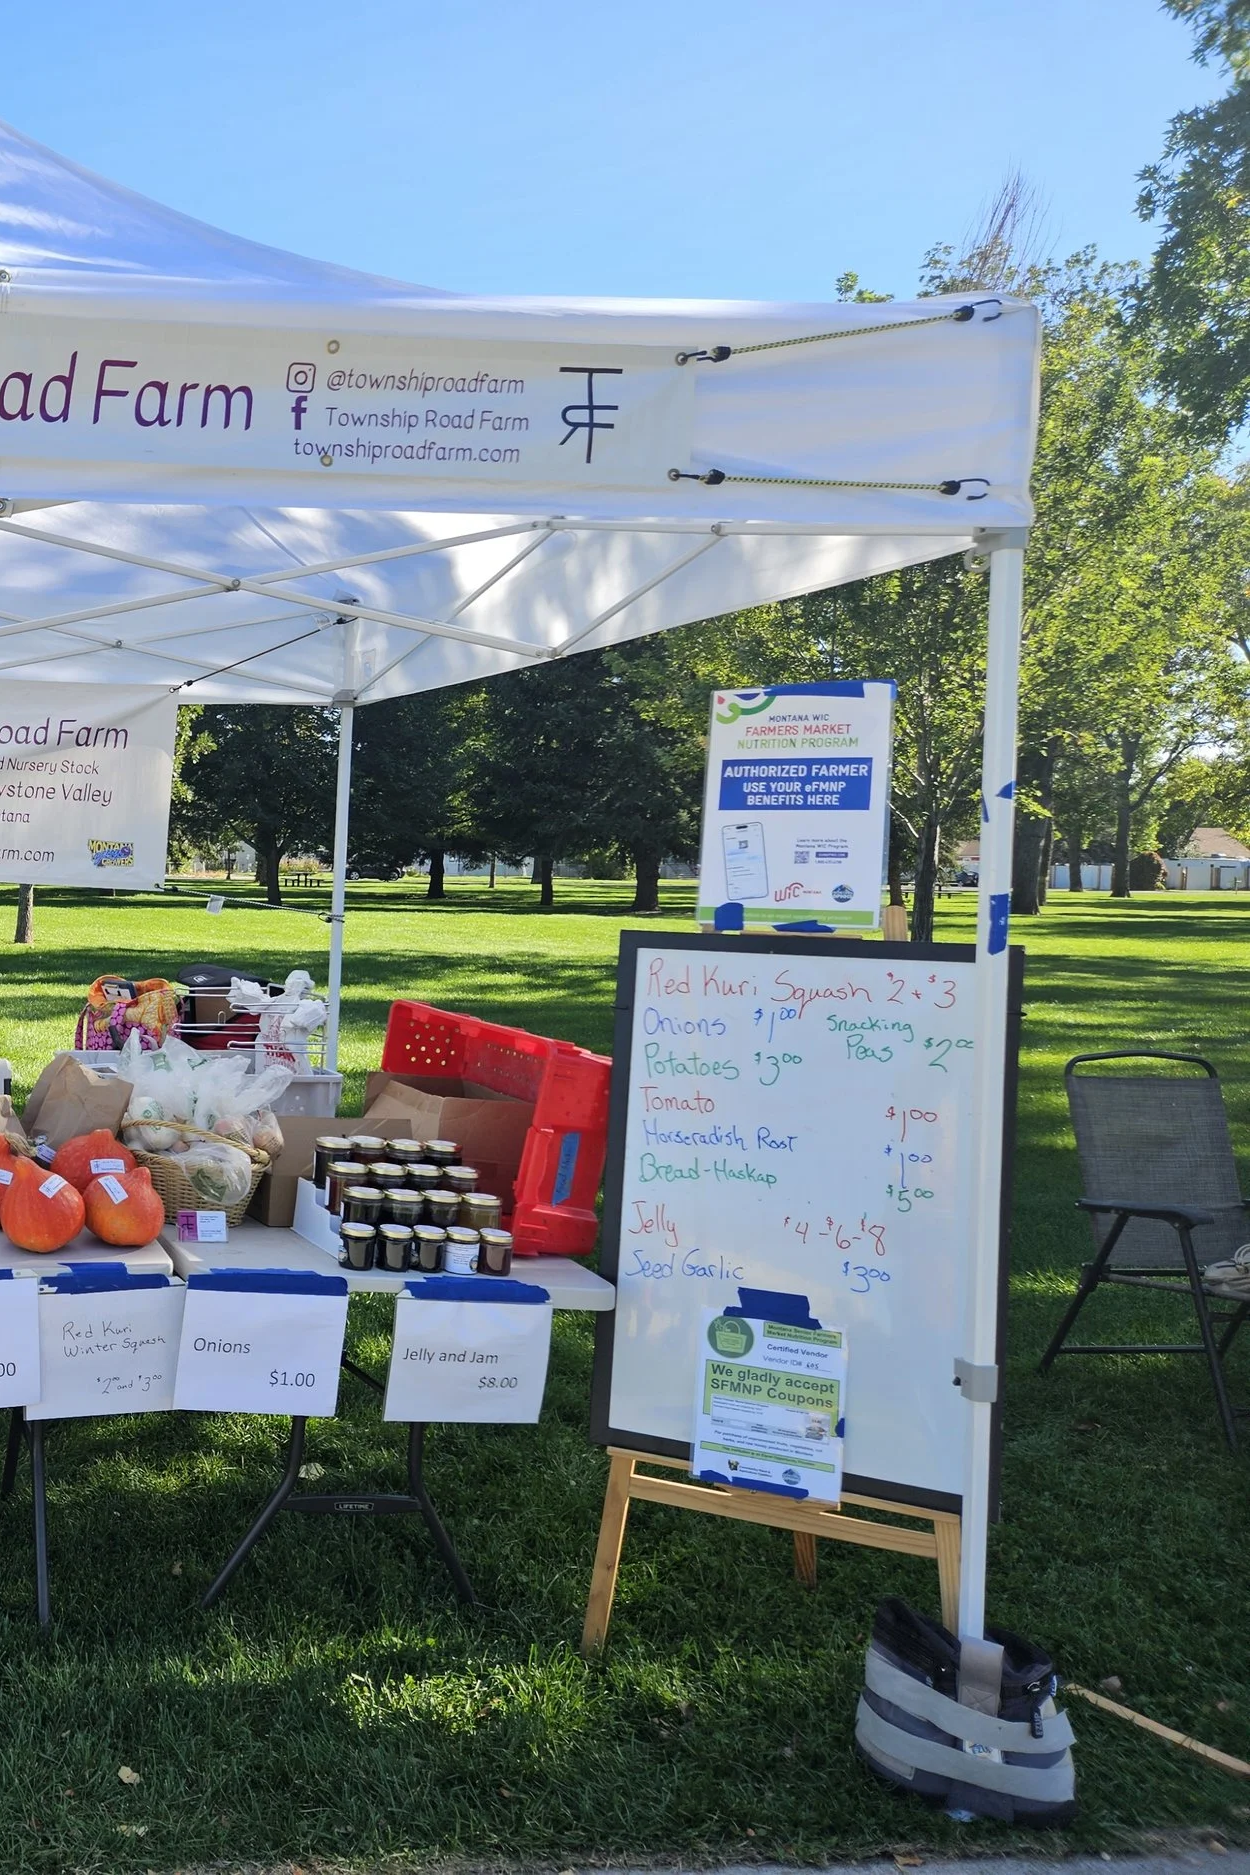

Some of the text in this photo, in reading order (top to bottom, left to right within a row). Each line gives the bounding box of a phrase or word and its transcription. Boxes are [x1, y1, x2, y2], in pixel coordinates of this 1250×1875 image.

[93, 359, 253, 431] Farm
[326, 369, 525, 398] @townshiproadfarm
[325, 407, 419, 433] Township
[425, 410, 476, 430] Road
[479, 411, 529, 432] Farm
[294, 438, 520, 465] townshiproadfarm.com
[769, 713, 830, 723] MONTANA WIC
[56, 719, 129, 750] Farm
[745, 724, 852, 737] FARMERS MARKET
[737, 737, 859, 750] NUTRITION PROGRAM
[7, 758, 57, 776] Nursery
[61, 760, 99, 776] Stock
[724, 764, 868, 778] AUTHORIZED FARMER
[61, 784, 113, 807] Valley
[742, 781, 846, 793] USE YOUR eFMNP
[746, 794, 840, 806] BENEFITS HERE
[649, 957, 691, 997] Red
[703, 965, 758, 997] Kuri
[770, 970, 872, 1019] Squash
[928, 974, 957, 1009] $3
[643, 1006, 726, 1037] Onions
[827, 1014, 915, 1043] Snacking
[846, 1034, 893, 1063] Peas
[644, 1042, 741, 1080] Potatoes
[639, 1086, 716, 1114] Tomato
[643, 1119, 748, 1151] Horseradish
[628, 1200, 679, 1248] Jelly
[624, 1249, 675, 1279] Seed
[681, 1248, 745, 1281] Garlic
[62, 1321, 132, 1340] Red Kuri
[64, 1336, 166, 1357] Winter Squash
[193, 1337, 251, 1355] Onions
[402, 1347, 499, 1366] Jelly and Jam
[767, 1344, 829, 1359] Certified Vendor
[763, 1356, 788, 1365] Vendor
[117, 1380, 133, 1390] and
[269, 1369, 316, 1388] $1.00
[477, 1375, 518, 1391] $8.00
[711, 1364, 834, 1395] We gladly accept
[710, 1379, 762, 1397] SFMNP
[767, 1388, 833, 1410] Coupons
